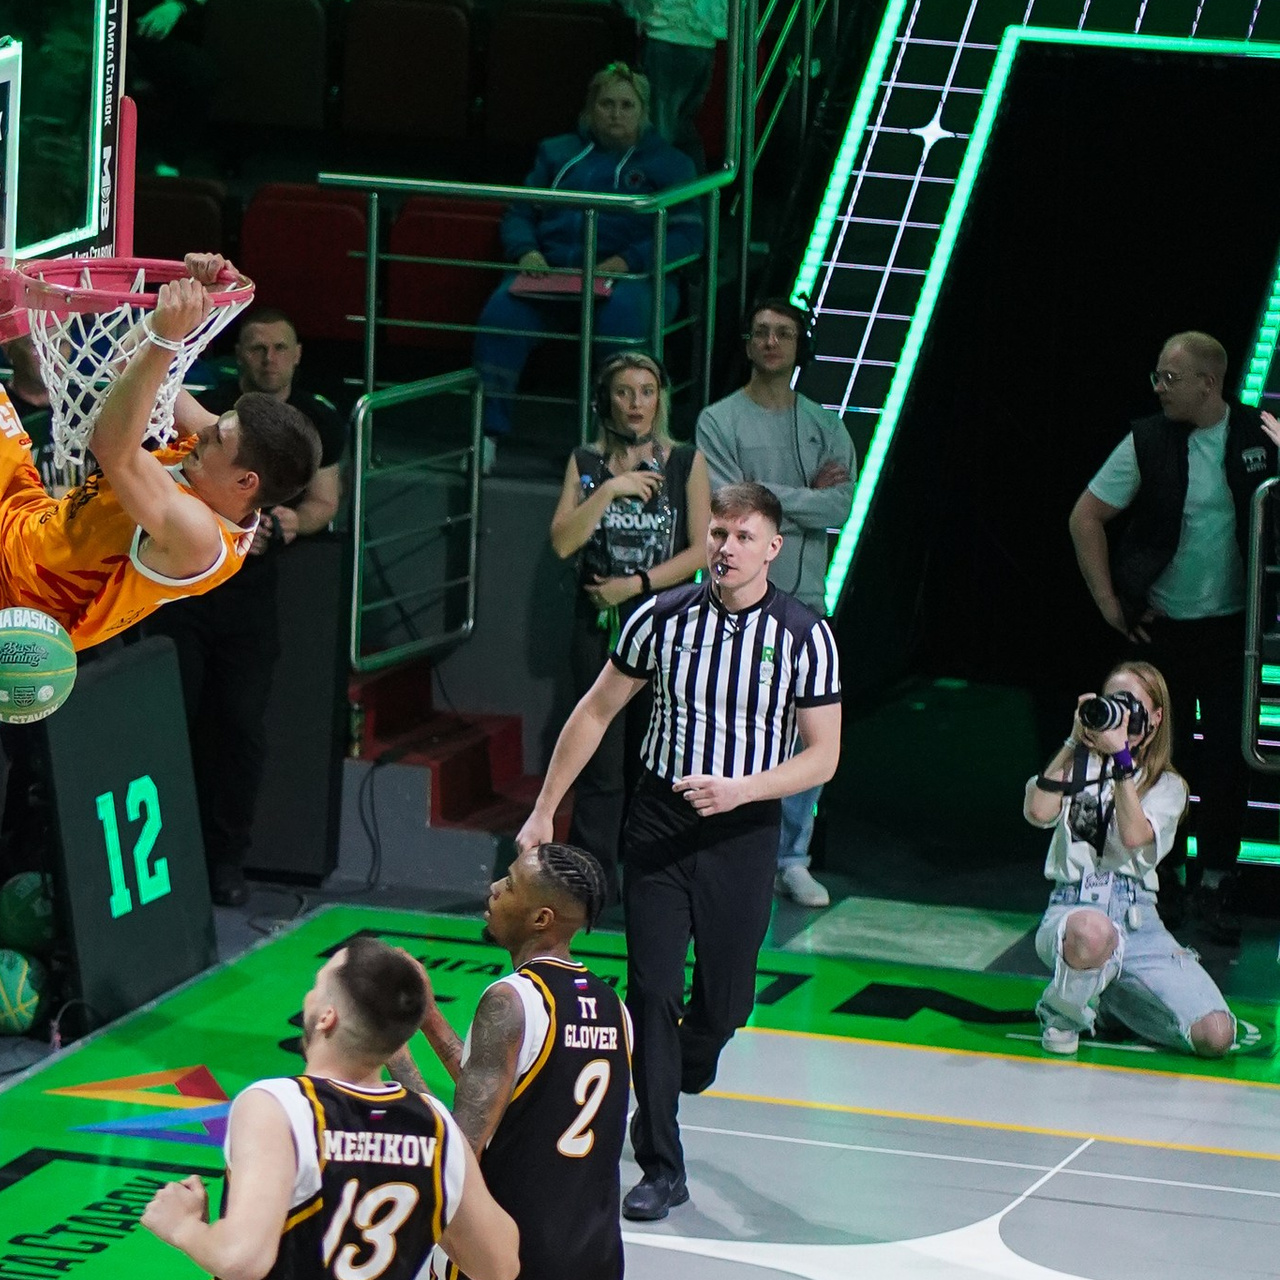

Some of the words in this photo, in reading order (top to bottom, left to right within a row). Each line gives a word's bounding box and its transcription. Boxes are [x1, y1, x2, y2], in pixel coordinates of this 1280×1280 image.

[13, 609, 61, 636] BASKET
[95, 774, 172, 920] 12
[577, 996, 597, 1020] TY
[564, 1024, 618, 1051] GLOVER
[556, 1058, 611, 1158] 2
[323, 1129, 437, 1167] MESHKOV
